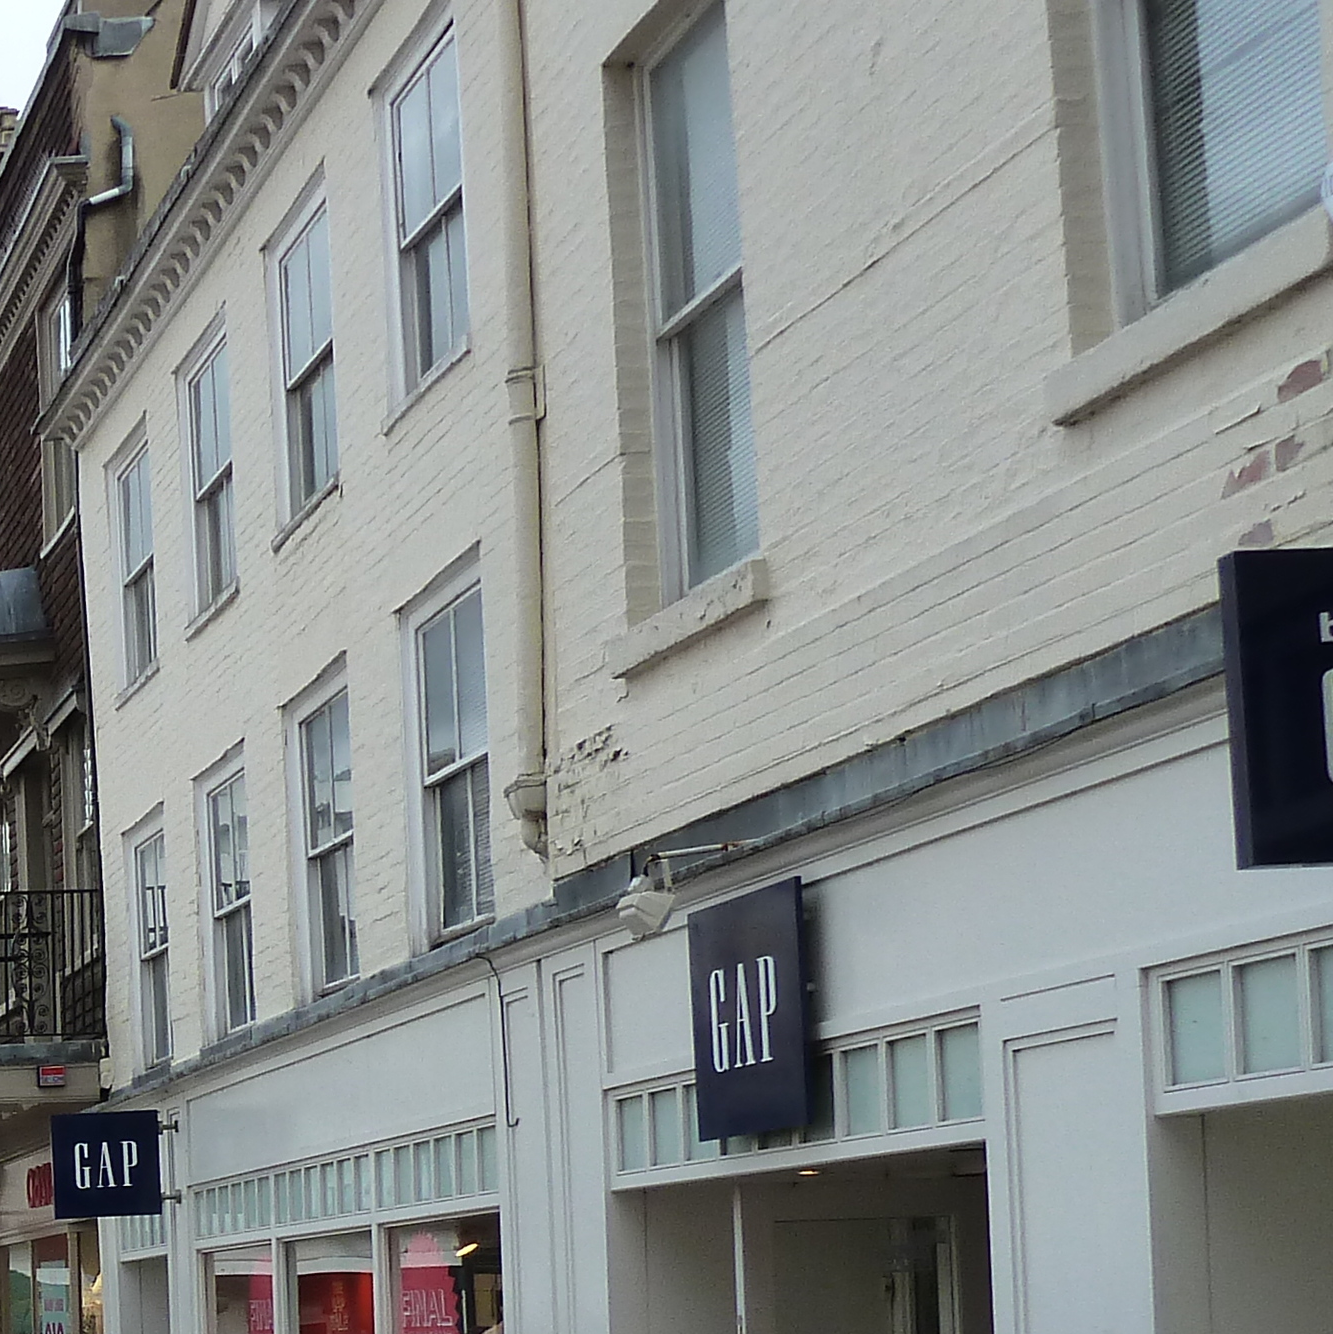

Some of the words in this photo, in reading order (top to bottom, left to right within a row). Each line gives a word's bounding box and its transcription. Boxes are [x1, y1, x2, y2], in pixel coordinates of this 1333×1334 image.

[709, 955, 777, 1073] GAP
[74, 1140, 138, 1190] GAP
[249, 1299, 273, 1331] FINA
[402, 1288, 453, 1328] FINAL
